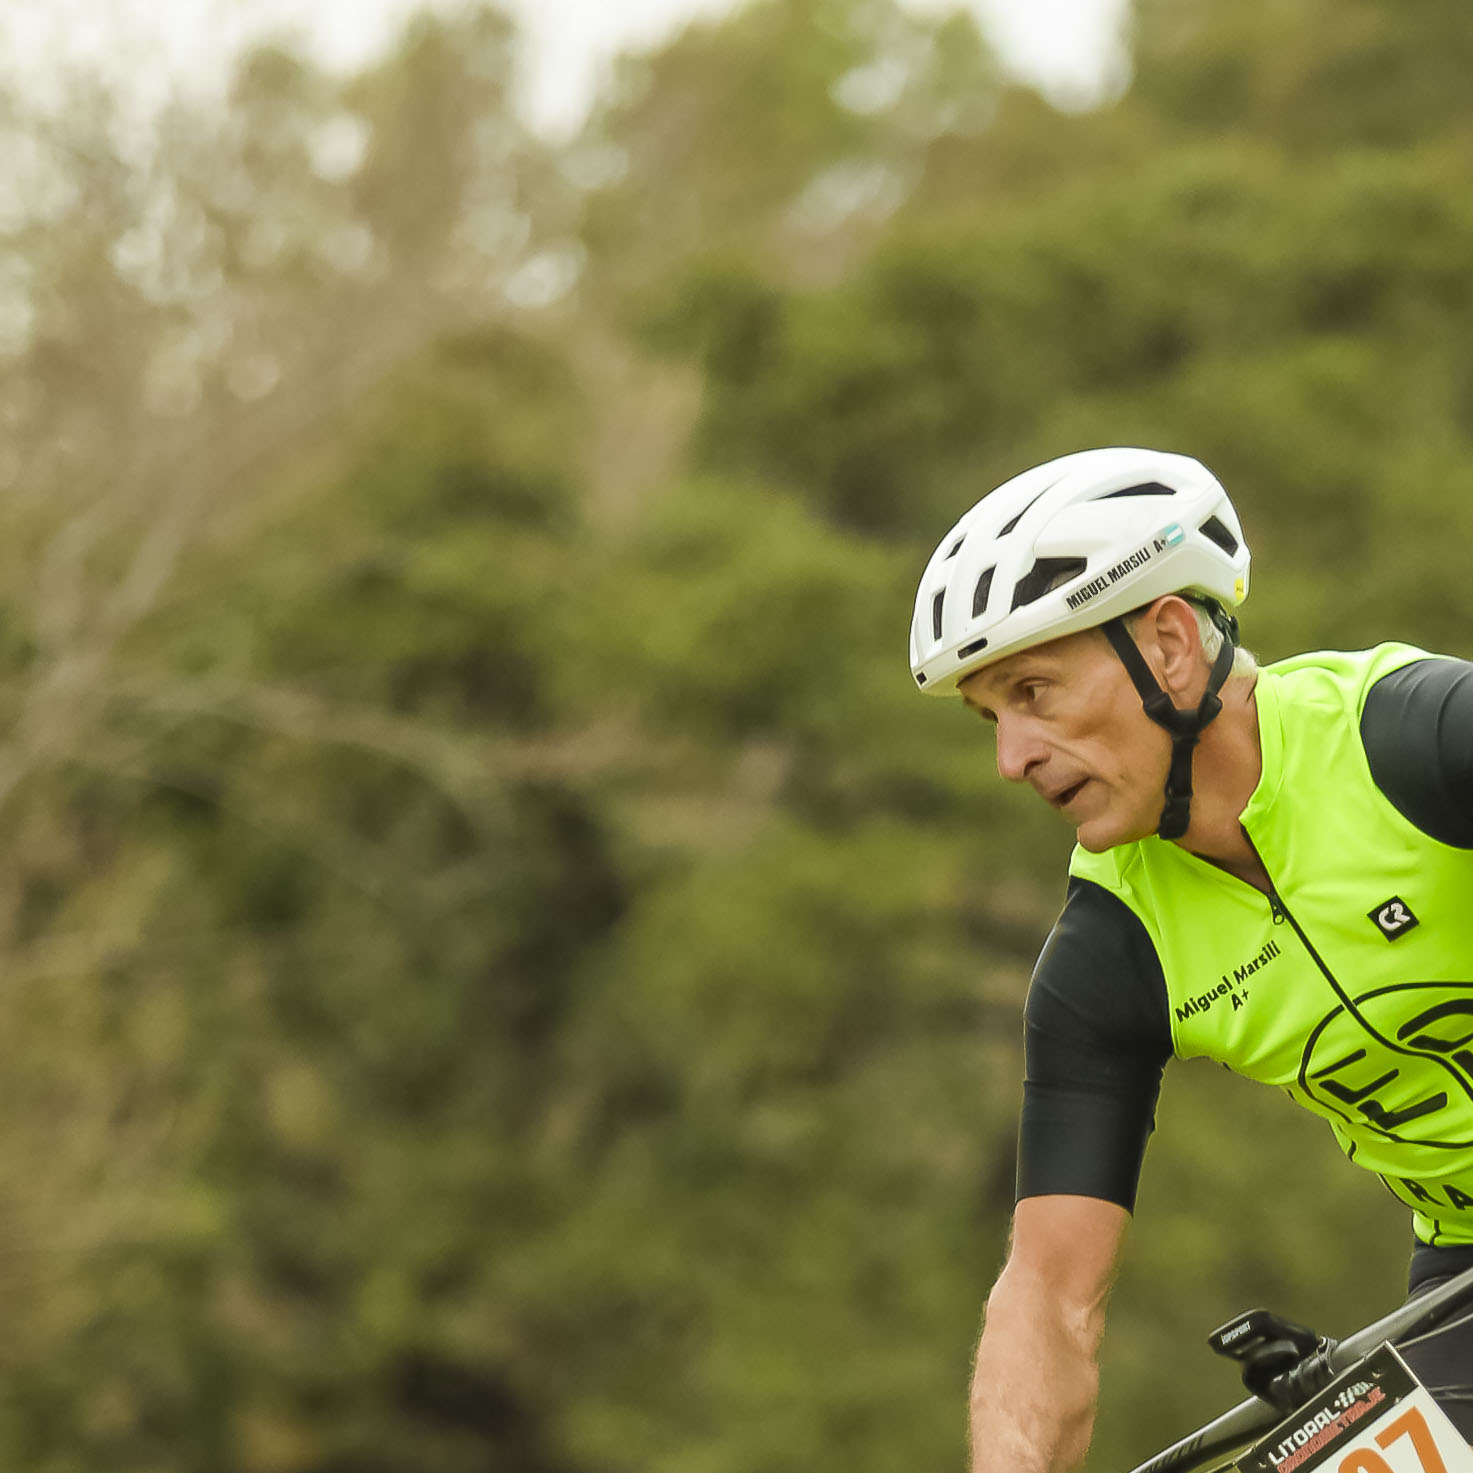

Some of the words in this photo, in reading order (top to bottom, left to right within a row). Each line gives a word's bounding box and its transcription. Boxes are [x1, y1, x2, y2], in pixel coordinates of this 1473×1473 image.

[1066, 576, 1110, 610] MIGUEL
[1107, 547, 1151, 583] MARSILI
[1175, 975, 1233, 1023] Miguel
[1231, 989, 1249, 1012] A+
[1268, 1407, 1341, 1466] LITORAL
